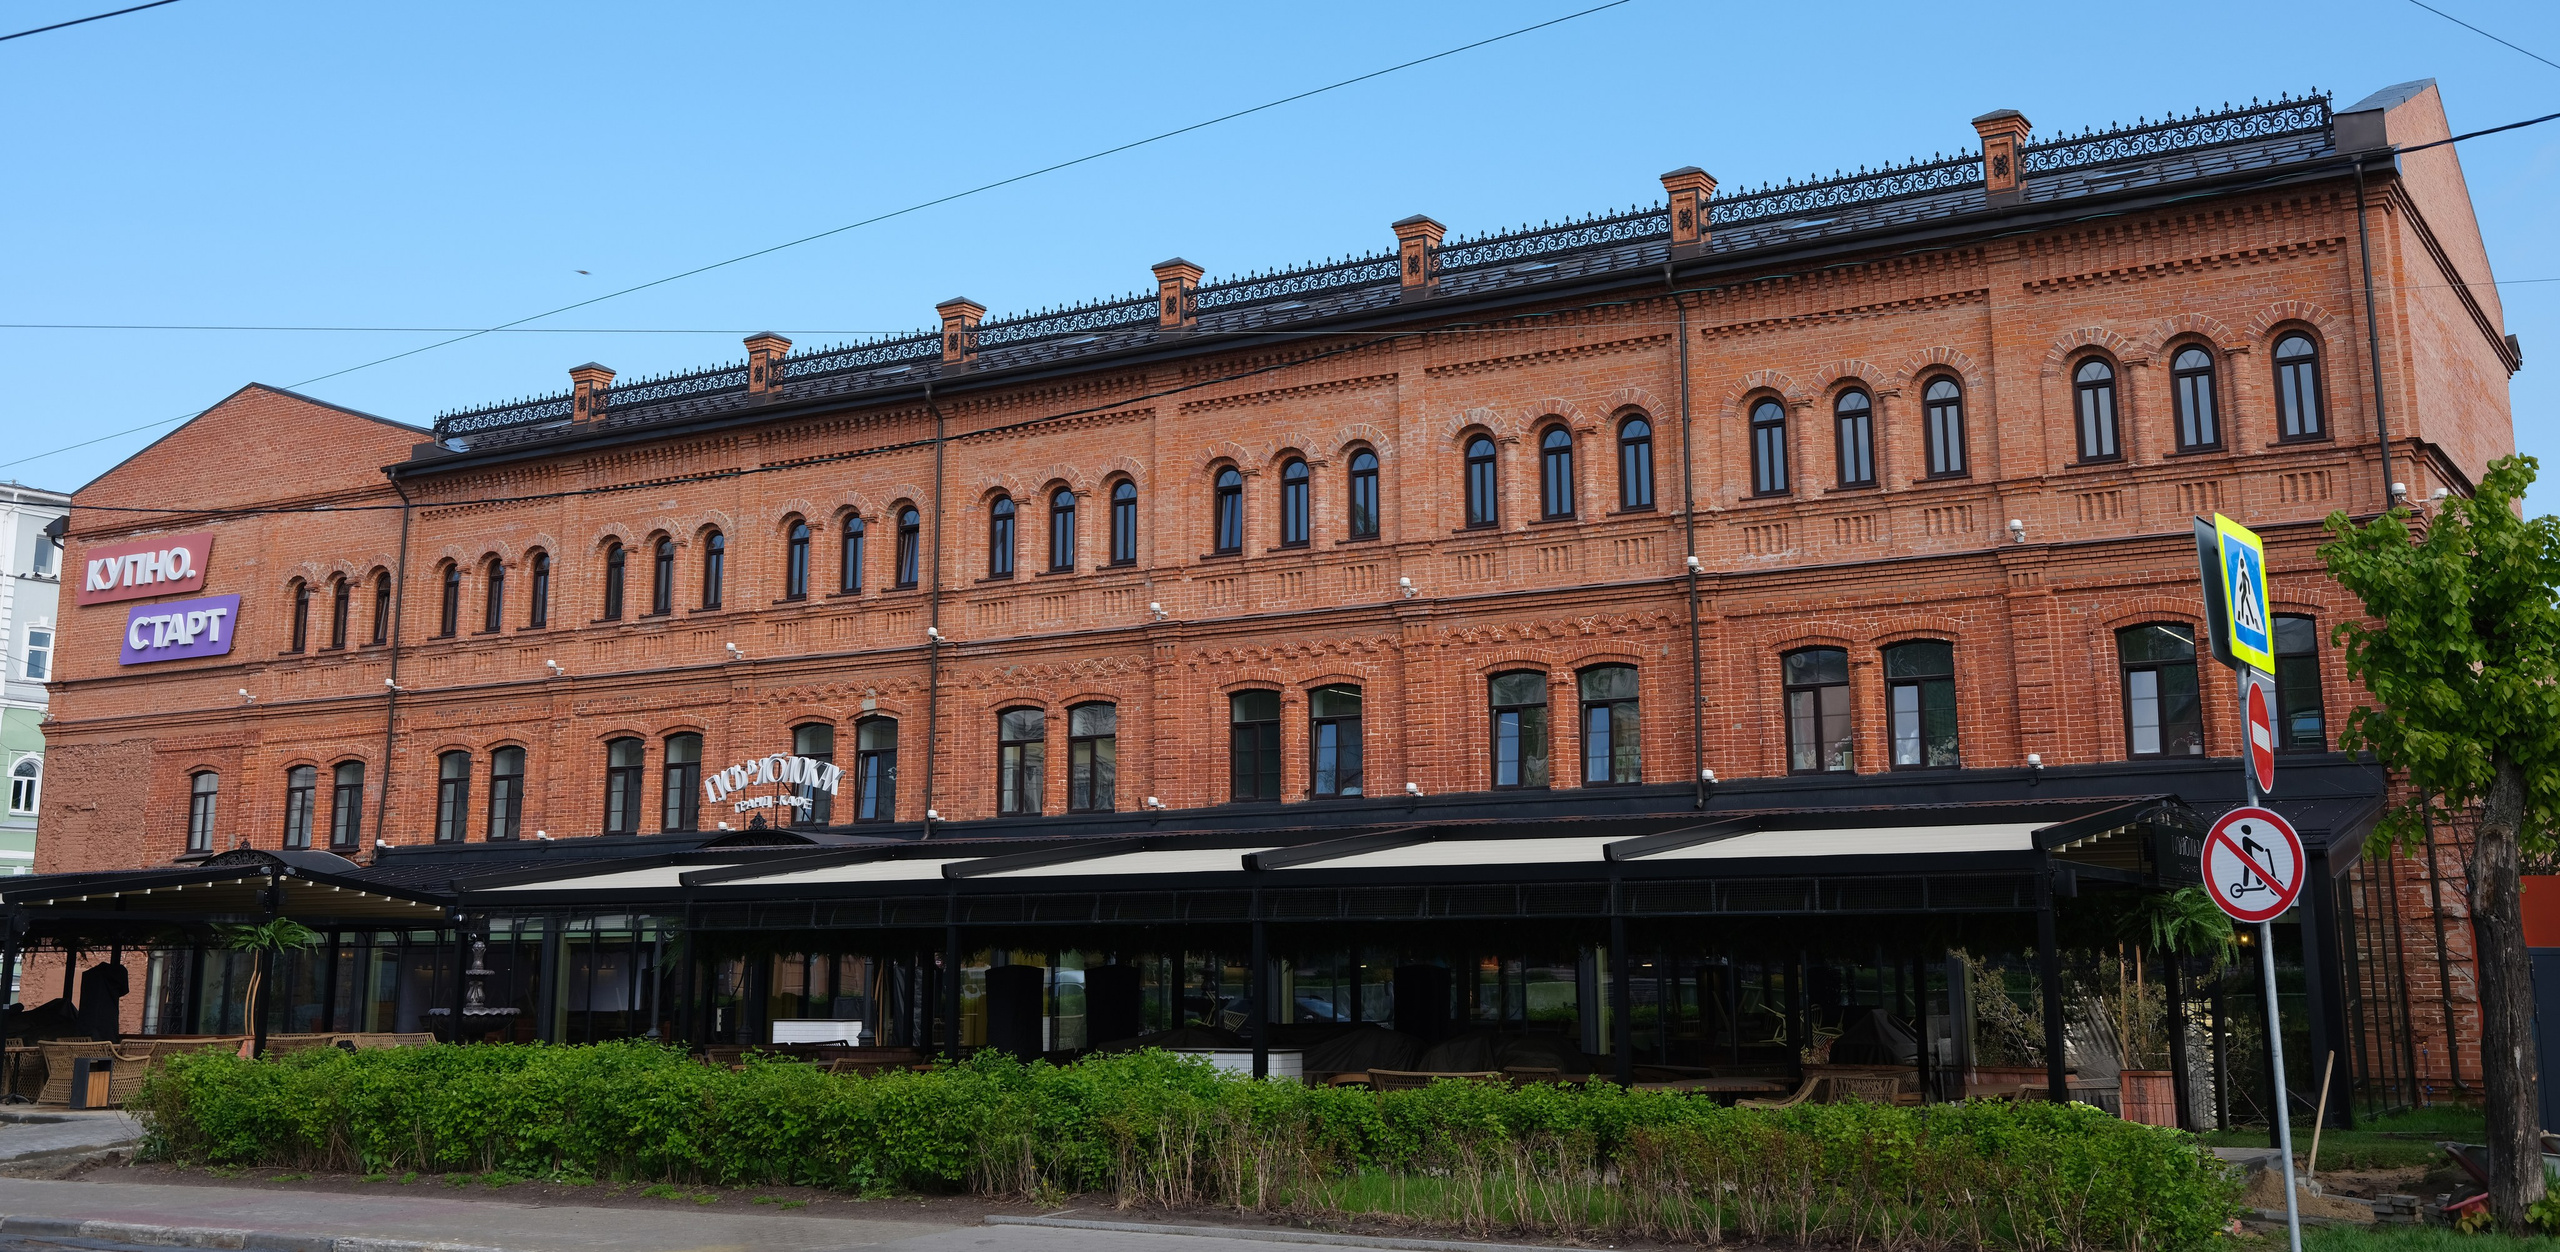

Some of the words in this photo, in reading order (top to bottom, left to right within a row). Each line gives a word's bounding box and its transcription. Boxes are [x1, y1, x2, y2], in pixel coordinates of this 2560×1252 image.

[87, 547, 196, 592] КУПНО.
[128, 608, 228, 650] СТАРТ
[704, 764, 749, 803] ГУСЬ
[752, 751, 847, 796] ЯБЛОКАХ
